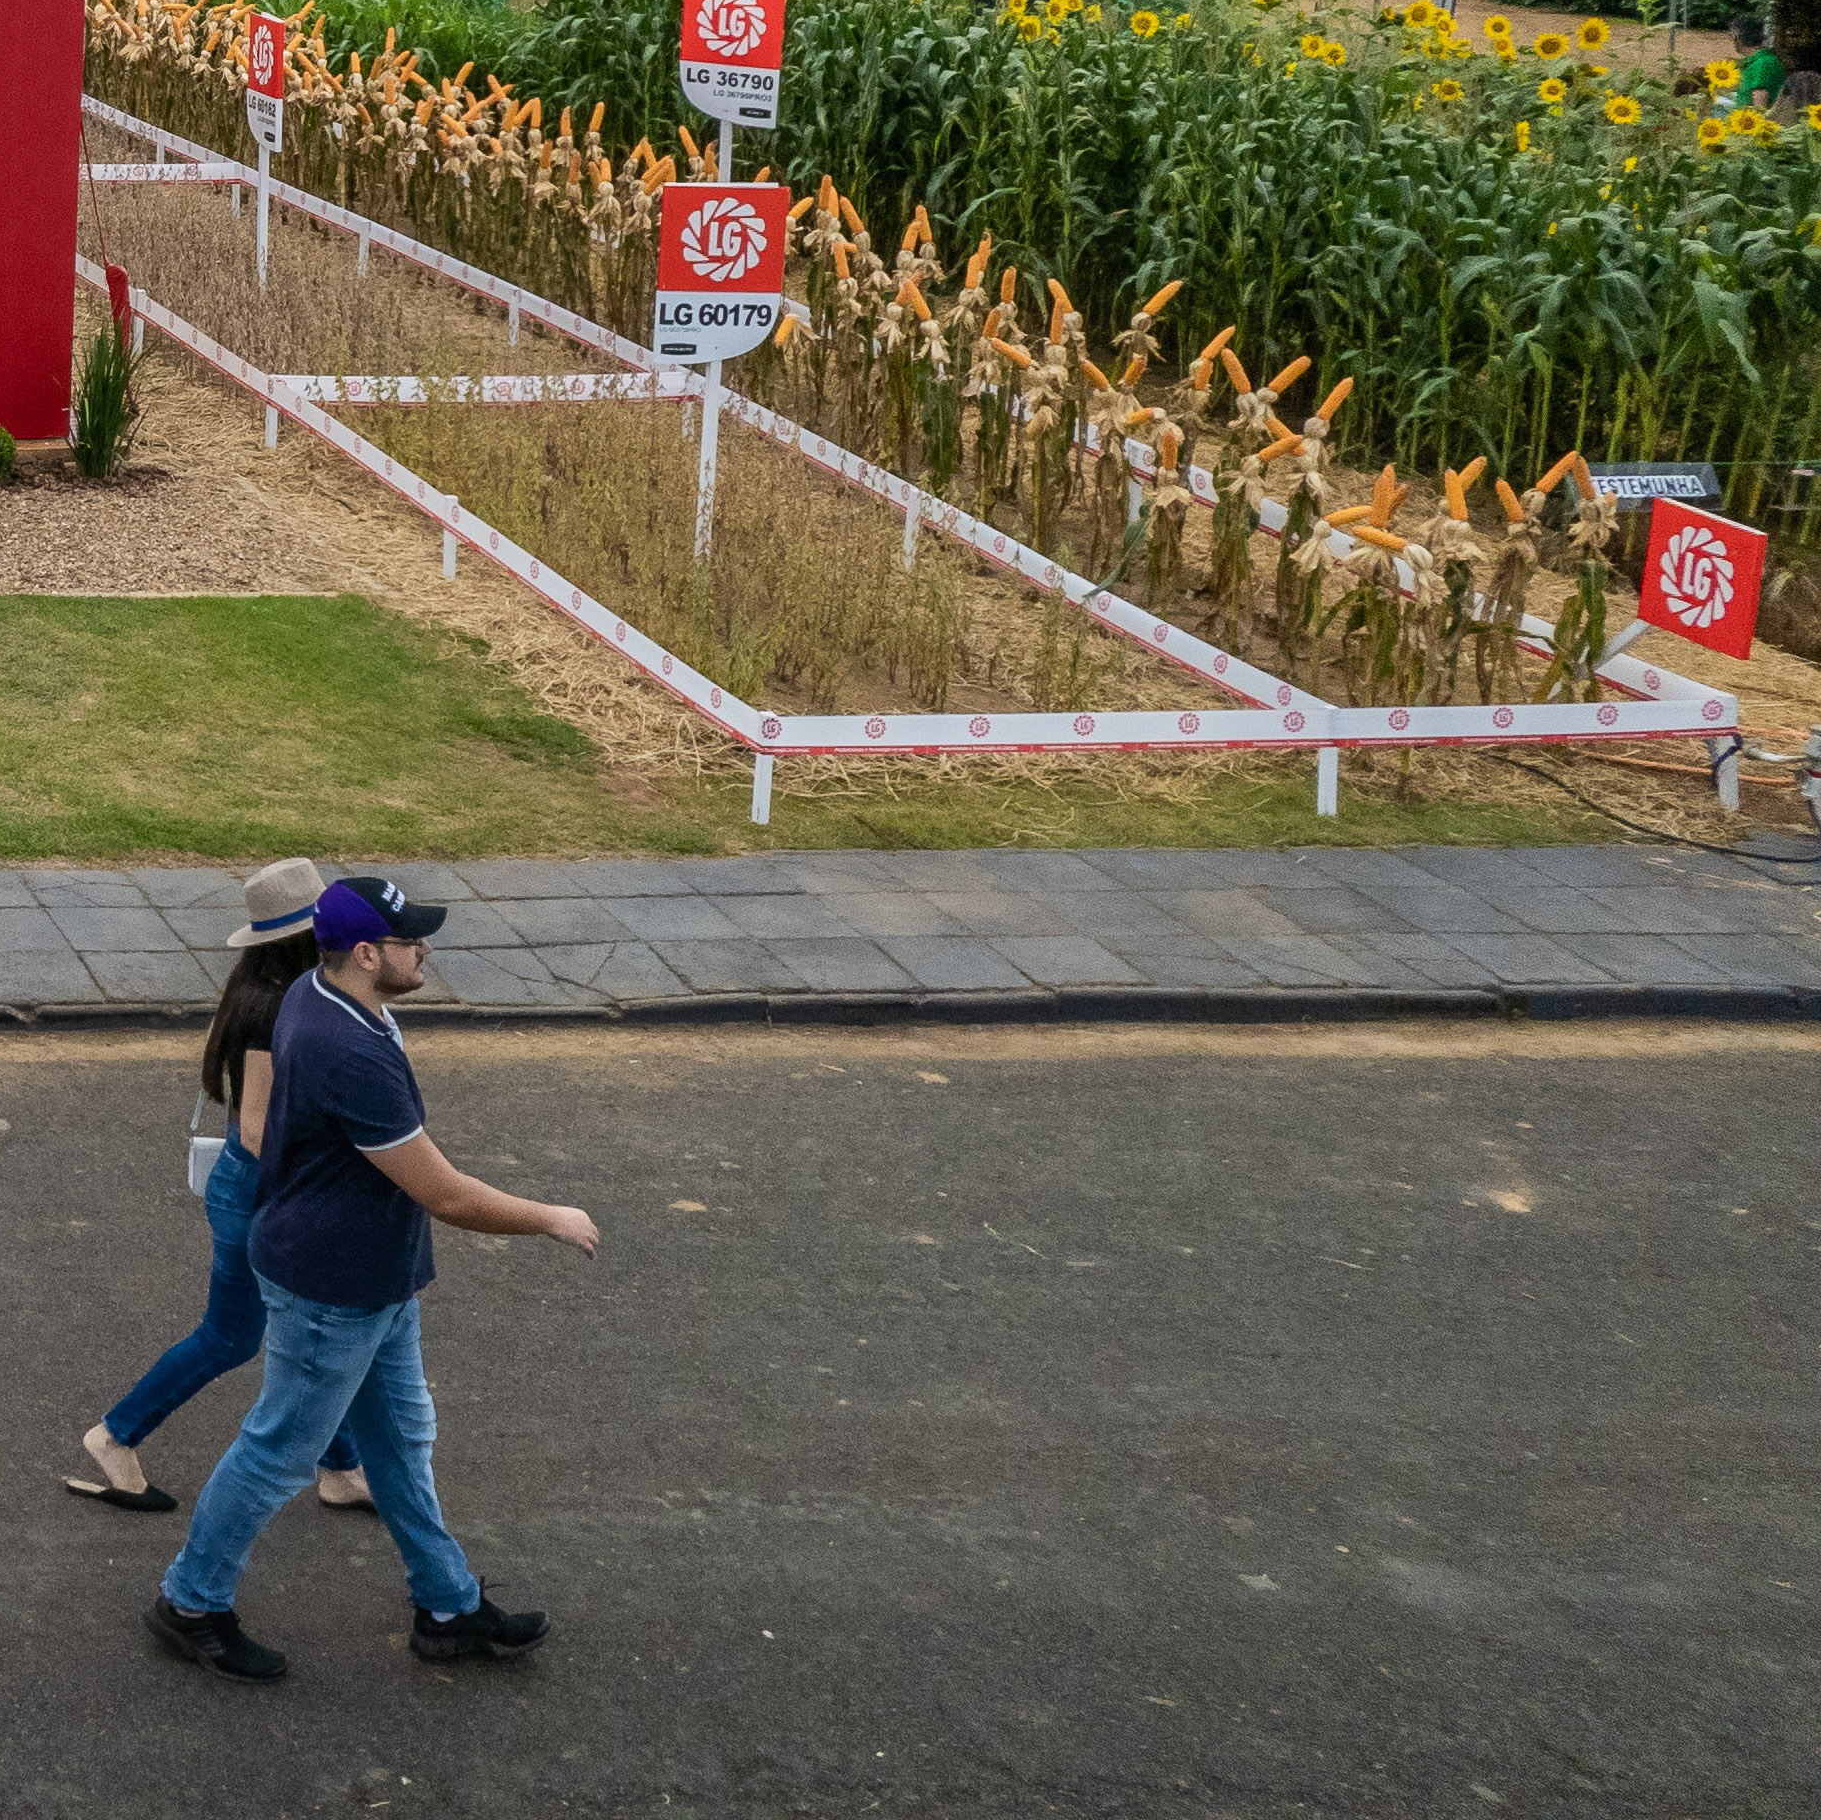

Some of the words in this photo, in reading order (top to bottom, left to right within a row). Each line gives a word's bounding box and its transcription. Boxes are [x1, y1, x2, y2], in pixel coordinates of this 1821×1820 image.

[718, 8, 746, 38] LG
[686, 67, 710, 84] LG
[717, 71, 774, 91] 36790
[713, 89, 725, 97] LG
[709, 221, 742, 257] LG
[659, 303, 693, 325] LG
[698, 303, 772, 327] 60179
[1595, 476, 1705, 496] ESTEMUNHA
[1682, 551, 1712, 600] LG
